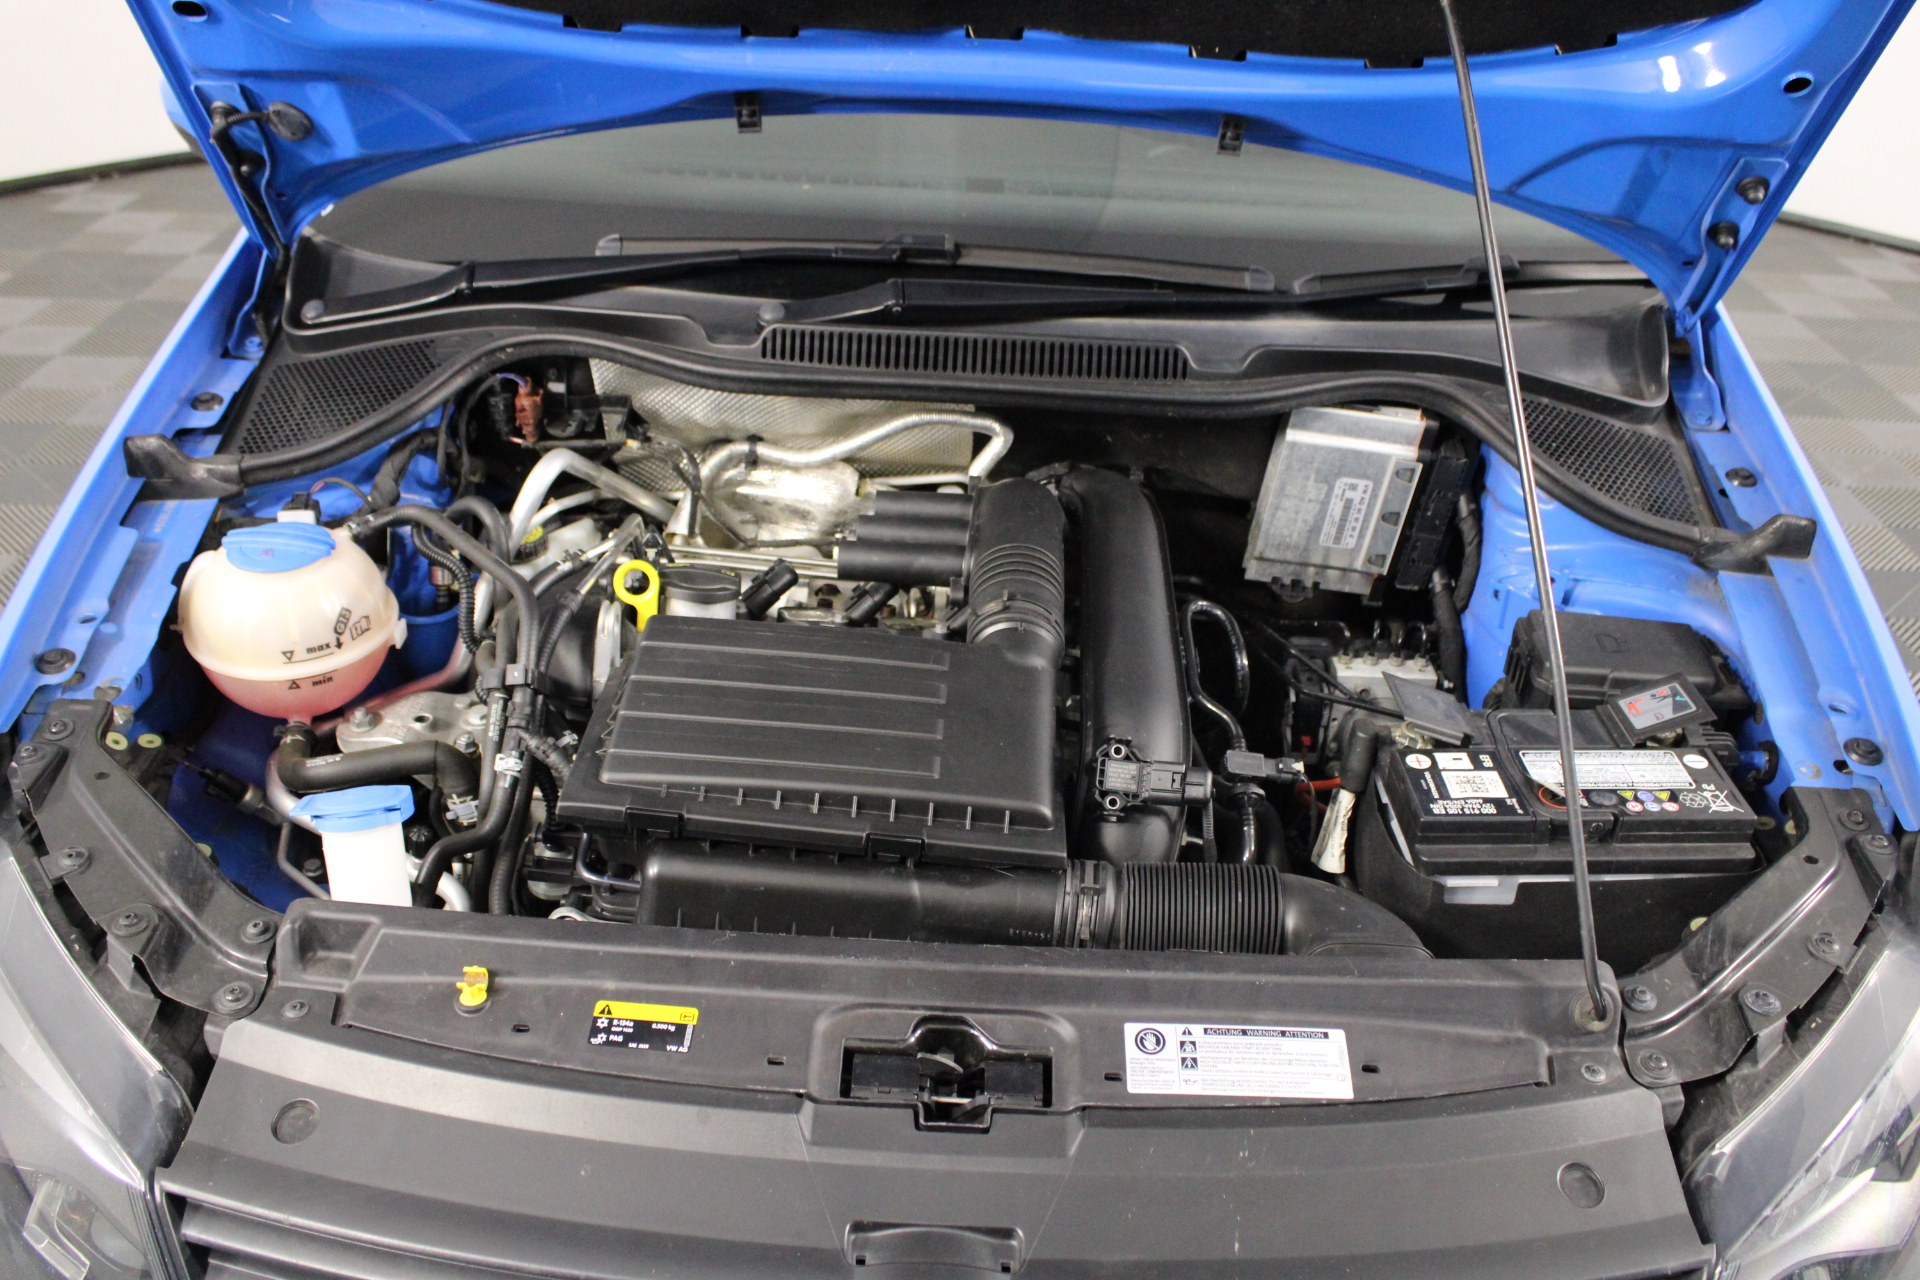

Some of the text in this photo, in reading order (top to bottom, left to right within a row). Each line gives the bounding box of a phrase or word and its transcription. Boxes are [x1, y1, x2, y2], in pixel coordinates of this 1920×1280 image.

[306, 642, 331, 654] max
[312, 676, 333, 686] min
[1478, 754, 1494, 768] EFB
[1424, 772, 1440, 798] VOLKSWAGEN
